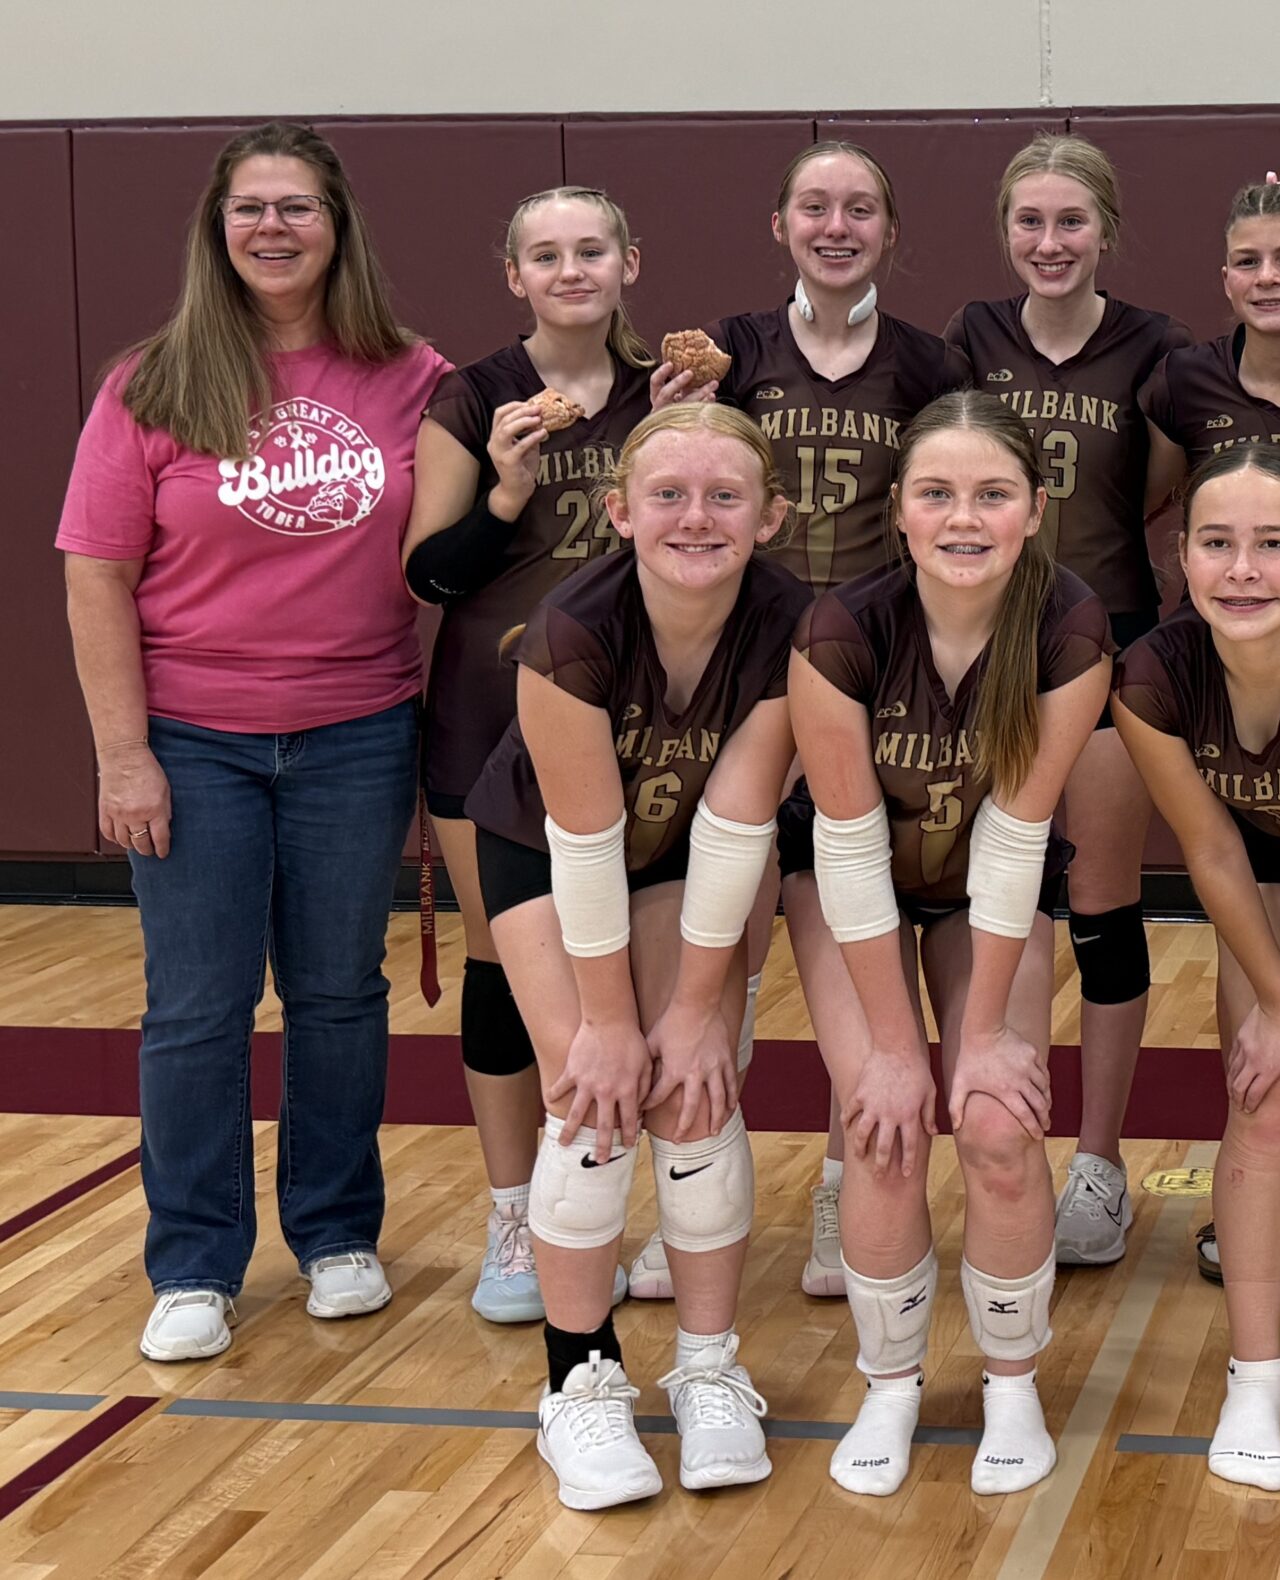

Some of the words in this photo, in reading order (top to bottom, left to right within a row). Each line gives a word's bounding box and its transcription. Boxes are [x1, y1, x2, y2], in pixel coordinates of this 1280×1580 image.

[275, 402, 332, 425] GREAT
[332, 418, 367, 447] DAY
[760, 407, 900, 450] MILBANK
[1000, 390, 1119, 434] ILBANK
[217, 443, 385, 506] Bulldog
[535, 447, 624, 486] MILBA
[796, 446, 864, 515] 15
[256, 500, 271, 521] TO
[276, 511, 296, 528] BE
[296, 515, 305, 529] A
[616, 726, 720, 767] MIBAN
[874, 729, 981, 773] MILBA
[632, 771, 684, 823] 6
[919, 774, 964, 833] 5
[421, 862, 433, 935] MILBANK
